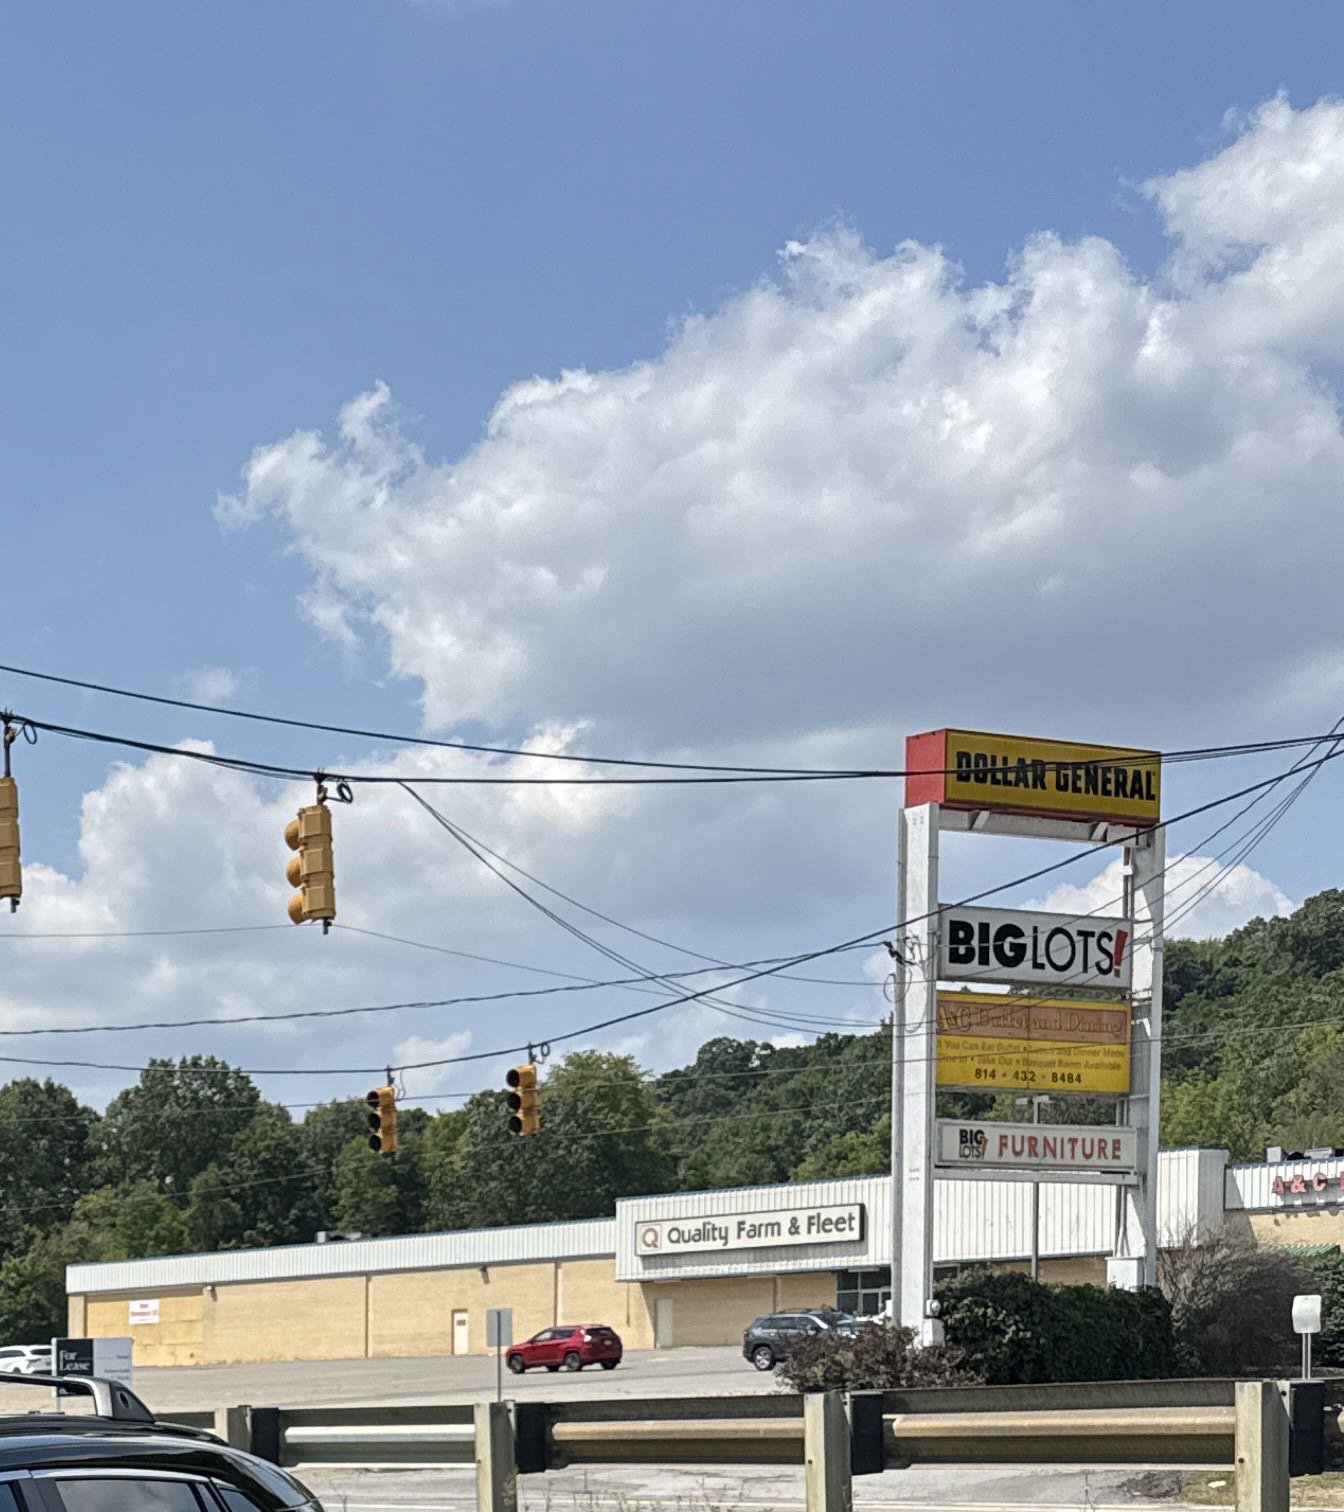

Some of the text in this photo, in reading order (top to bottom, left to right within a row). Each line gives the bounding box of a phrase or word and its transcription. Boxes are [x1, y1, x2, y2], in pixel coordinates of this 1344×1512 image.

[956, 751, 1156, 800] DOLLAR GENERAL
[975, 1069, 1082, 1083] 814 432 8484
[959, 1129, 985, 1145] BIG
[998, 1135, 1121, 1160] FURNITURE
[1290, 1174, 1307, 1193] &
[1312, 1172, 1328, 1192] C
[667, 1221, 729, 1246] Quality
[736, 1220, 781, 1240] Farm
[787, 1216, 800, 1236] &
[807, 1212, 855, 1235] Fleet
[59, 1350, 78, 1361] For
[59, 1361, 91, 1371] Lease
